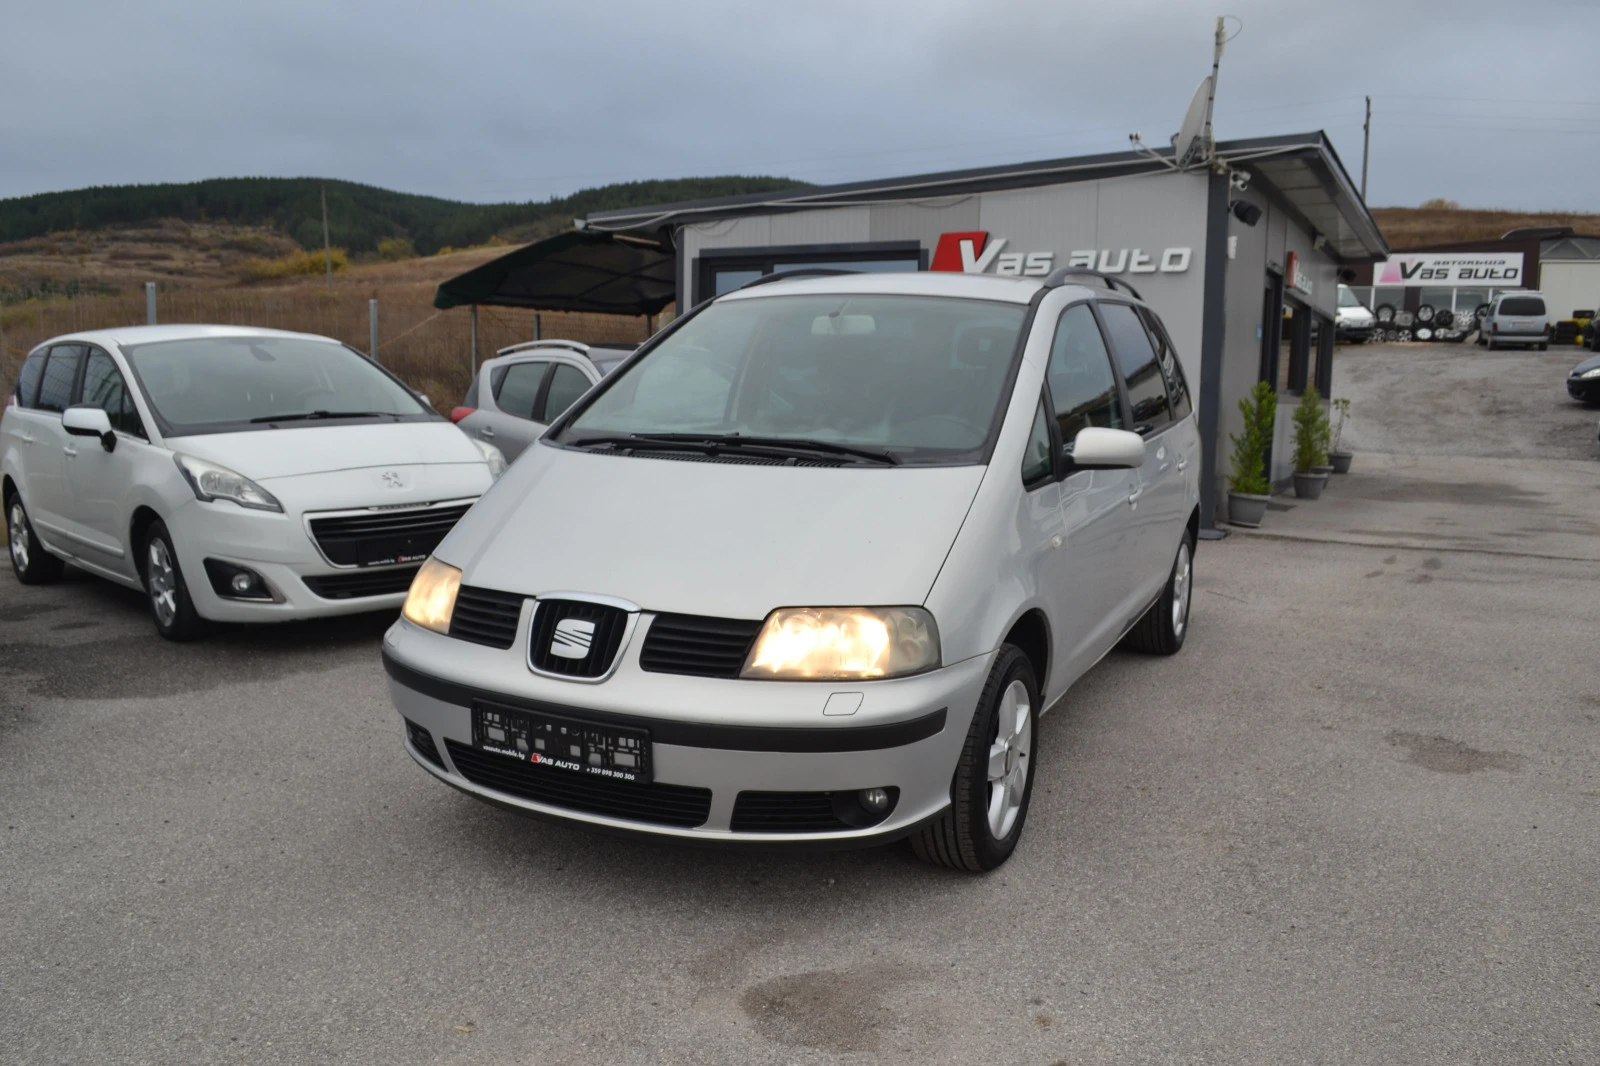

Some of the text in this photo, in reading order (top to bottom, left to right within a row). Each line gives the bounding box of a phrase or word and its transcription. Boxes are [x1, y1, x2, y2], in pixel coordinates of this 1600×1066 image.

[959, 238, 1192, 276] Vas auto
[1400, 261, 1519, 280] Vas auto
[554, 760, 580, 771] AUTO
[612, 771, 624, 779] 300
